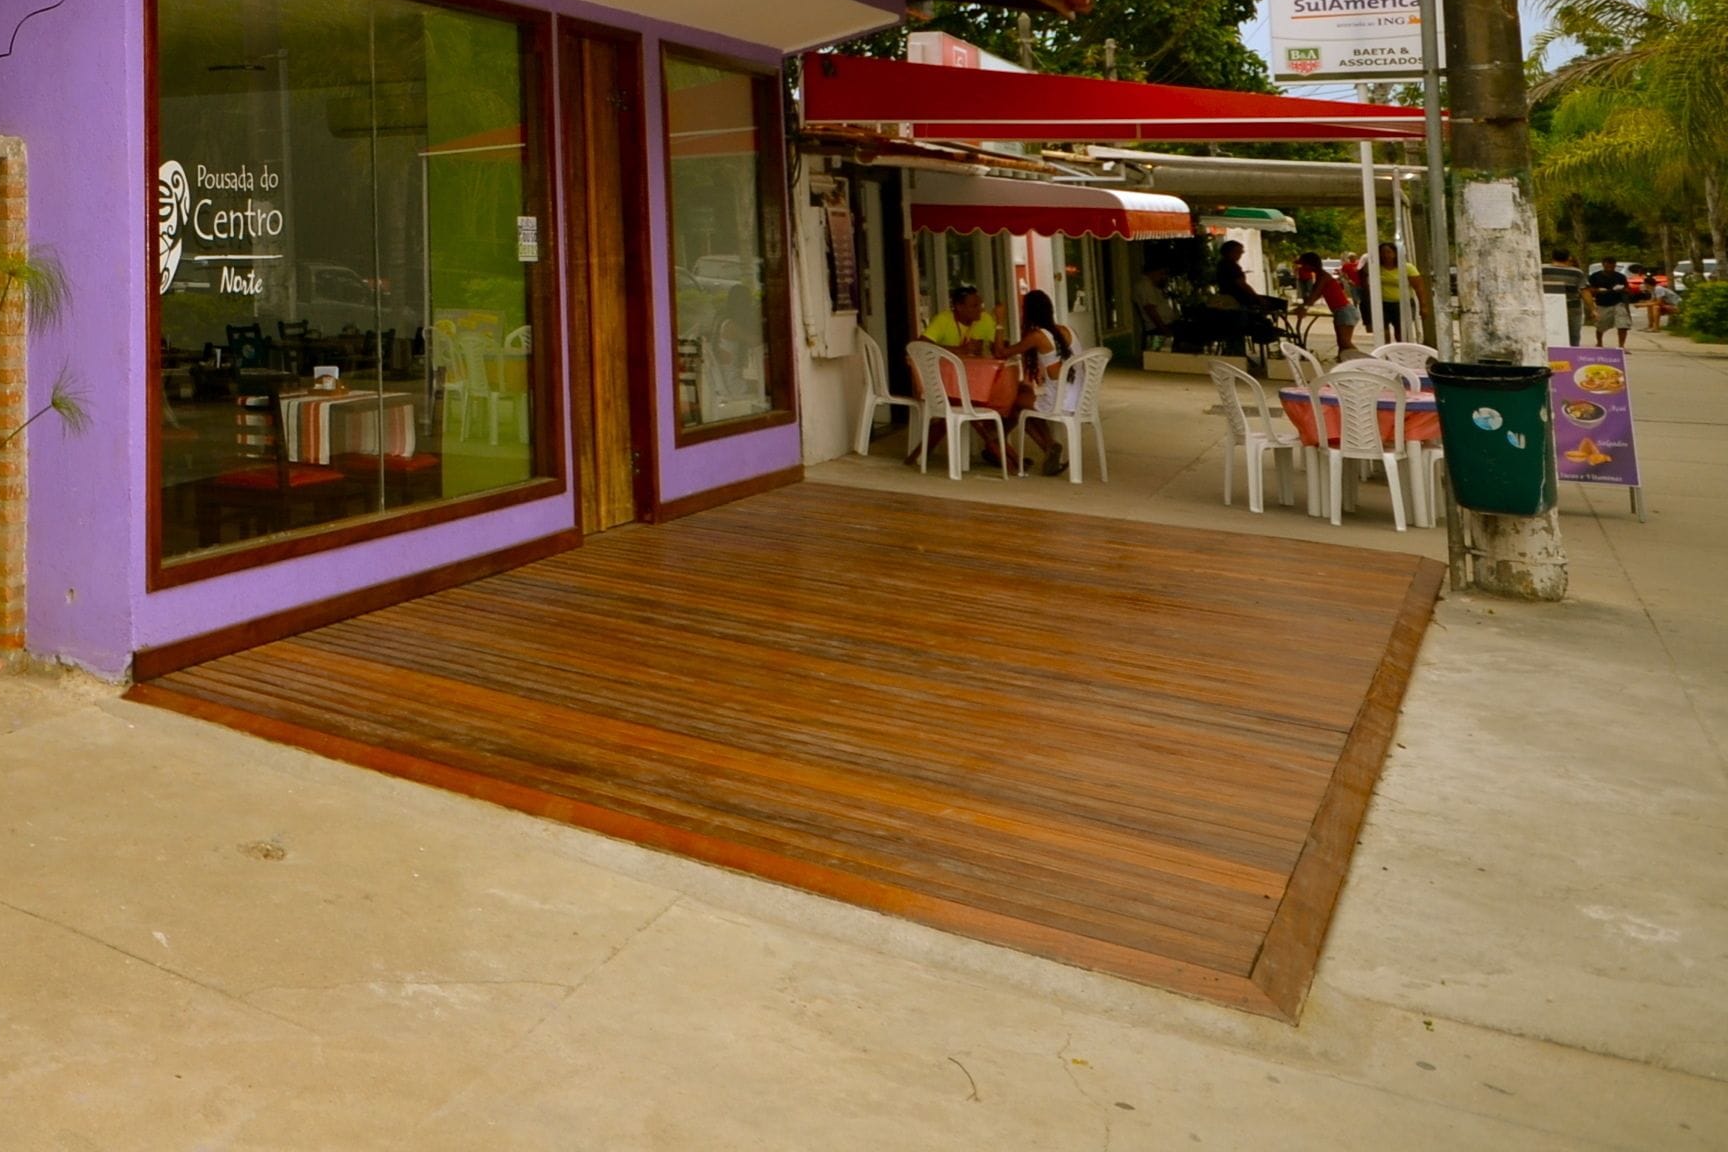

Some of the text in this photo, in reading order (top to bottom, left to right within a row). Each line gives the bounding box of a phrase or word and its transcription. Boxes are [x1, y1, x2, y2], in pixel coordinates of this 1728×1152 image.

[1377, 16, 1405, 26] ING
[1353, 47, 1410, 57] BAETA &
[197, 164, 279, 192] Pousada do
[194, 198, 283, 241] Centro
[220, 266, 263, 295] Norte
